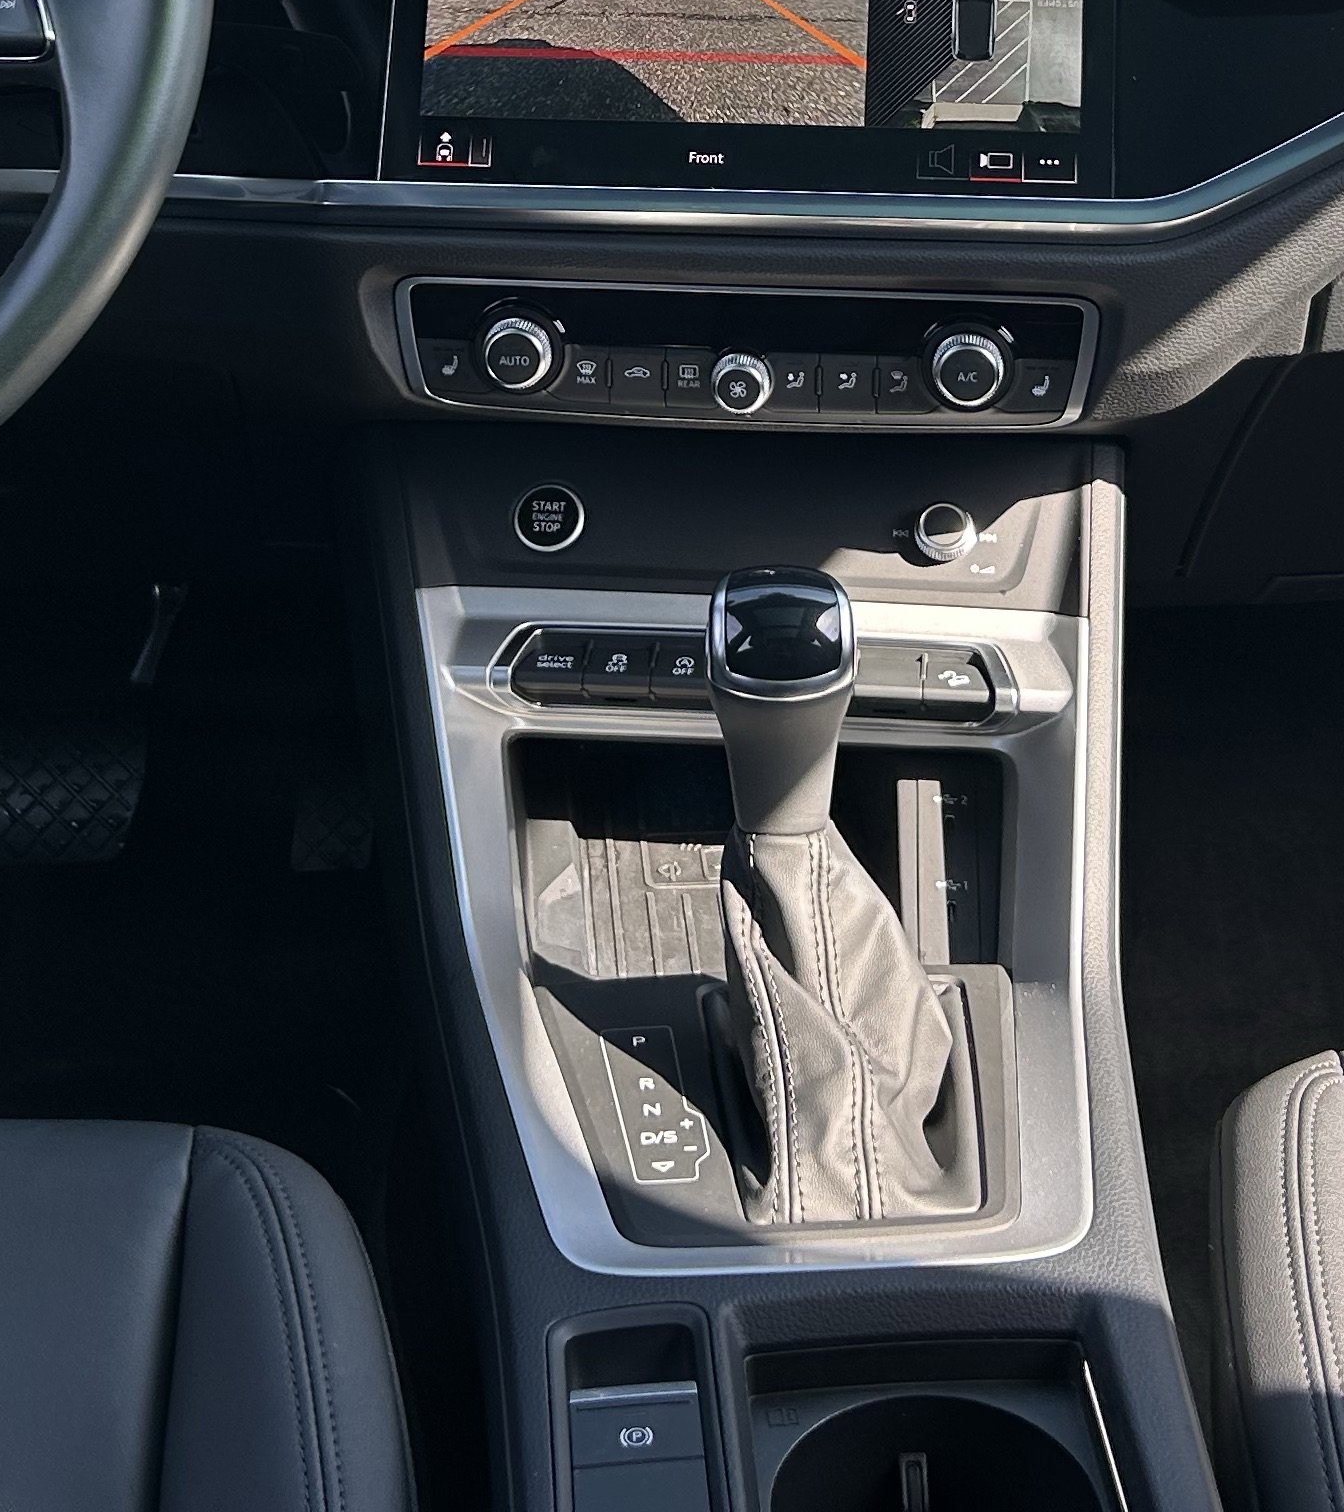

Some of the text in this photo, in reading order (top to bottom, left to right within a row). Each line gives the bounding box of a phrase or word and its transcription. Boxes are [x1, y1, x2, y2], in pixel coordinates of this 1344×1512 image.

[688, 151, 725, 165] Front
[498, 355, 531, 367] AUTO
[576, 375, 597, 385] MAX
[957, 371, 979, 383] A/C
[677, 379, 701, 388] REAR
[532, 500, 567, 512] START
[531, 512, 563, 522] ENGINE
[532, 521, 562, 533] STOP
[537, 653, 575, 662] drive
[536, 661, 573, 669] select
[605, 665, 628, 673] OFF
[672, 666, 695, 676] OFF
[632, 1035, 646, 1047] P
[638, 1076, 655, 1091] R
[642, 1102, 662, 1118] N
[640, 1130, 679, 1146] D/S
